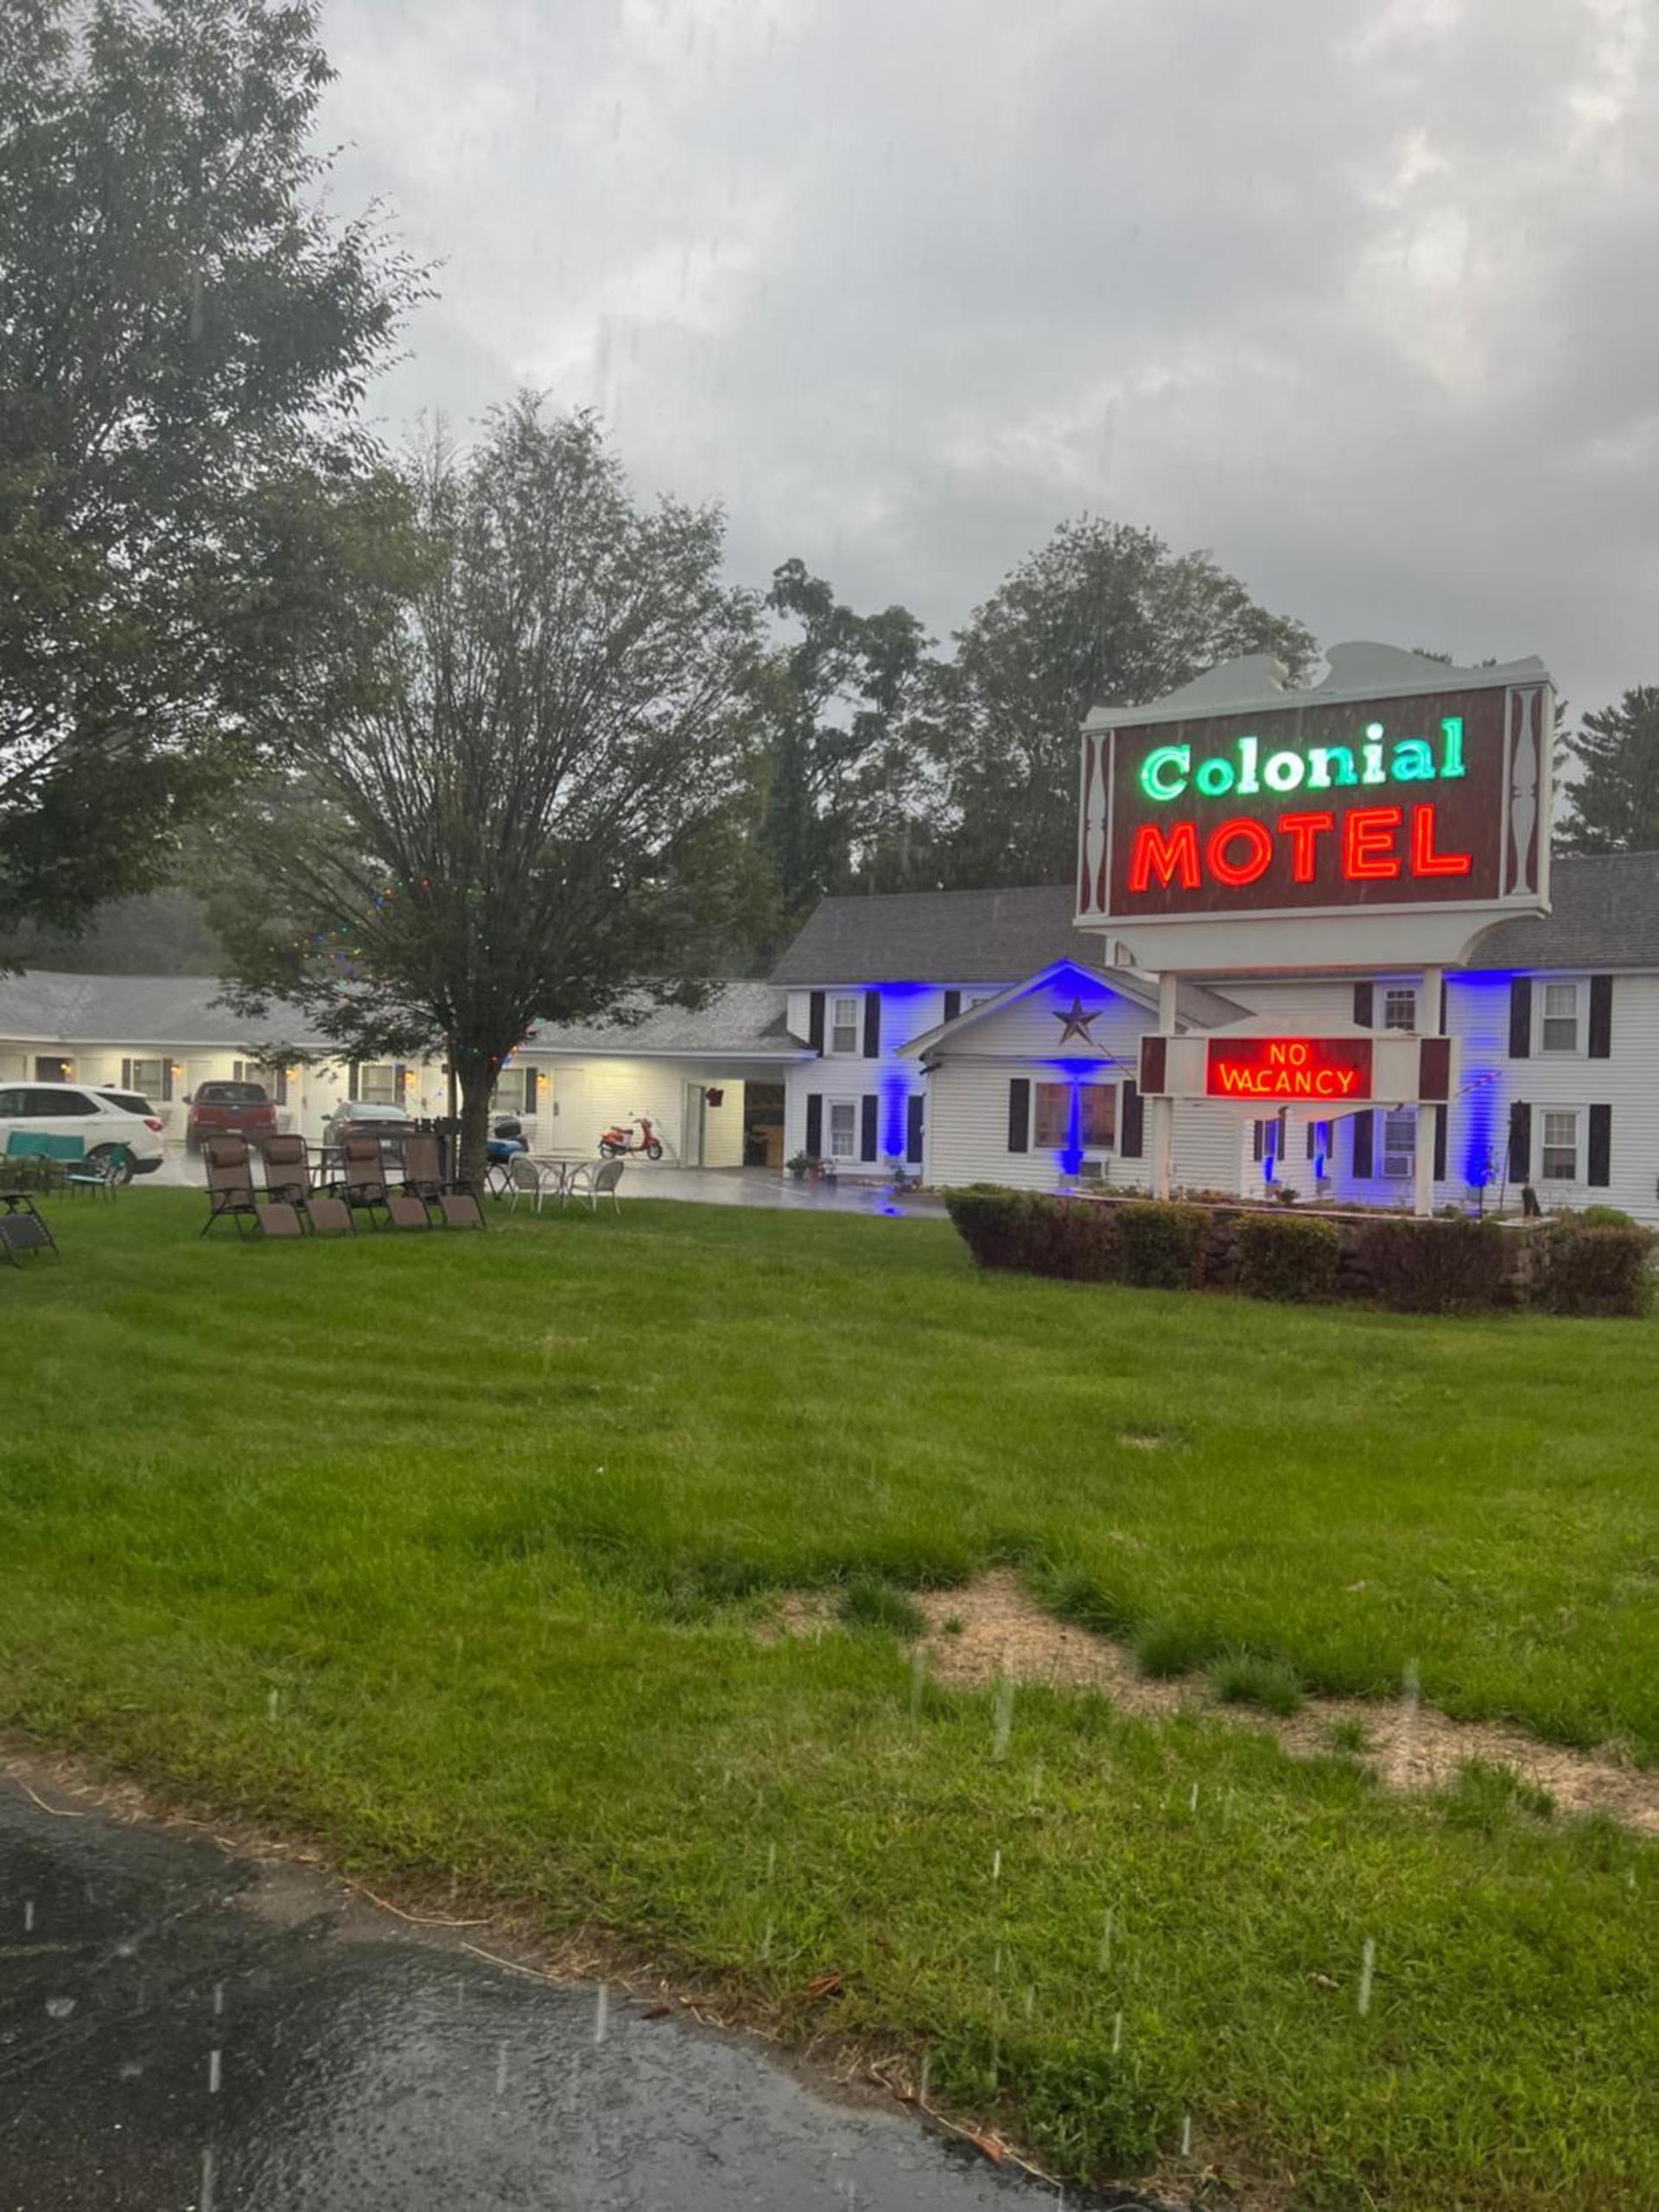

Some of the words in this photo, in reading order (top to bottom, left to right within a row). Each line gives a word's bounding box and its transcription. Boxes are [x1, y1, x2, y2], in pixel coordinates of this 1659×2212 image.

[1141, 717, 1465, 800] Colonial
[1130, 804, 1471, 891] MOTEL
[1219, 1063, 1355, 1094] VACANCY
[1269, 1043, 1307, 1065] NO
